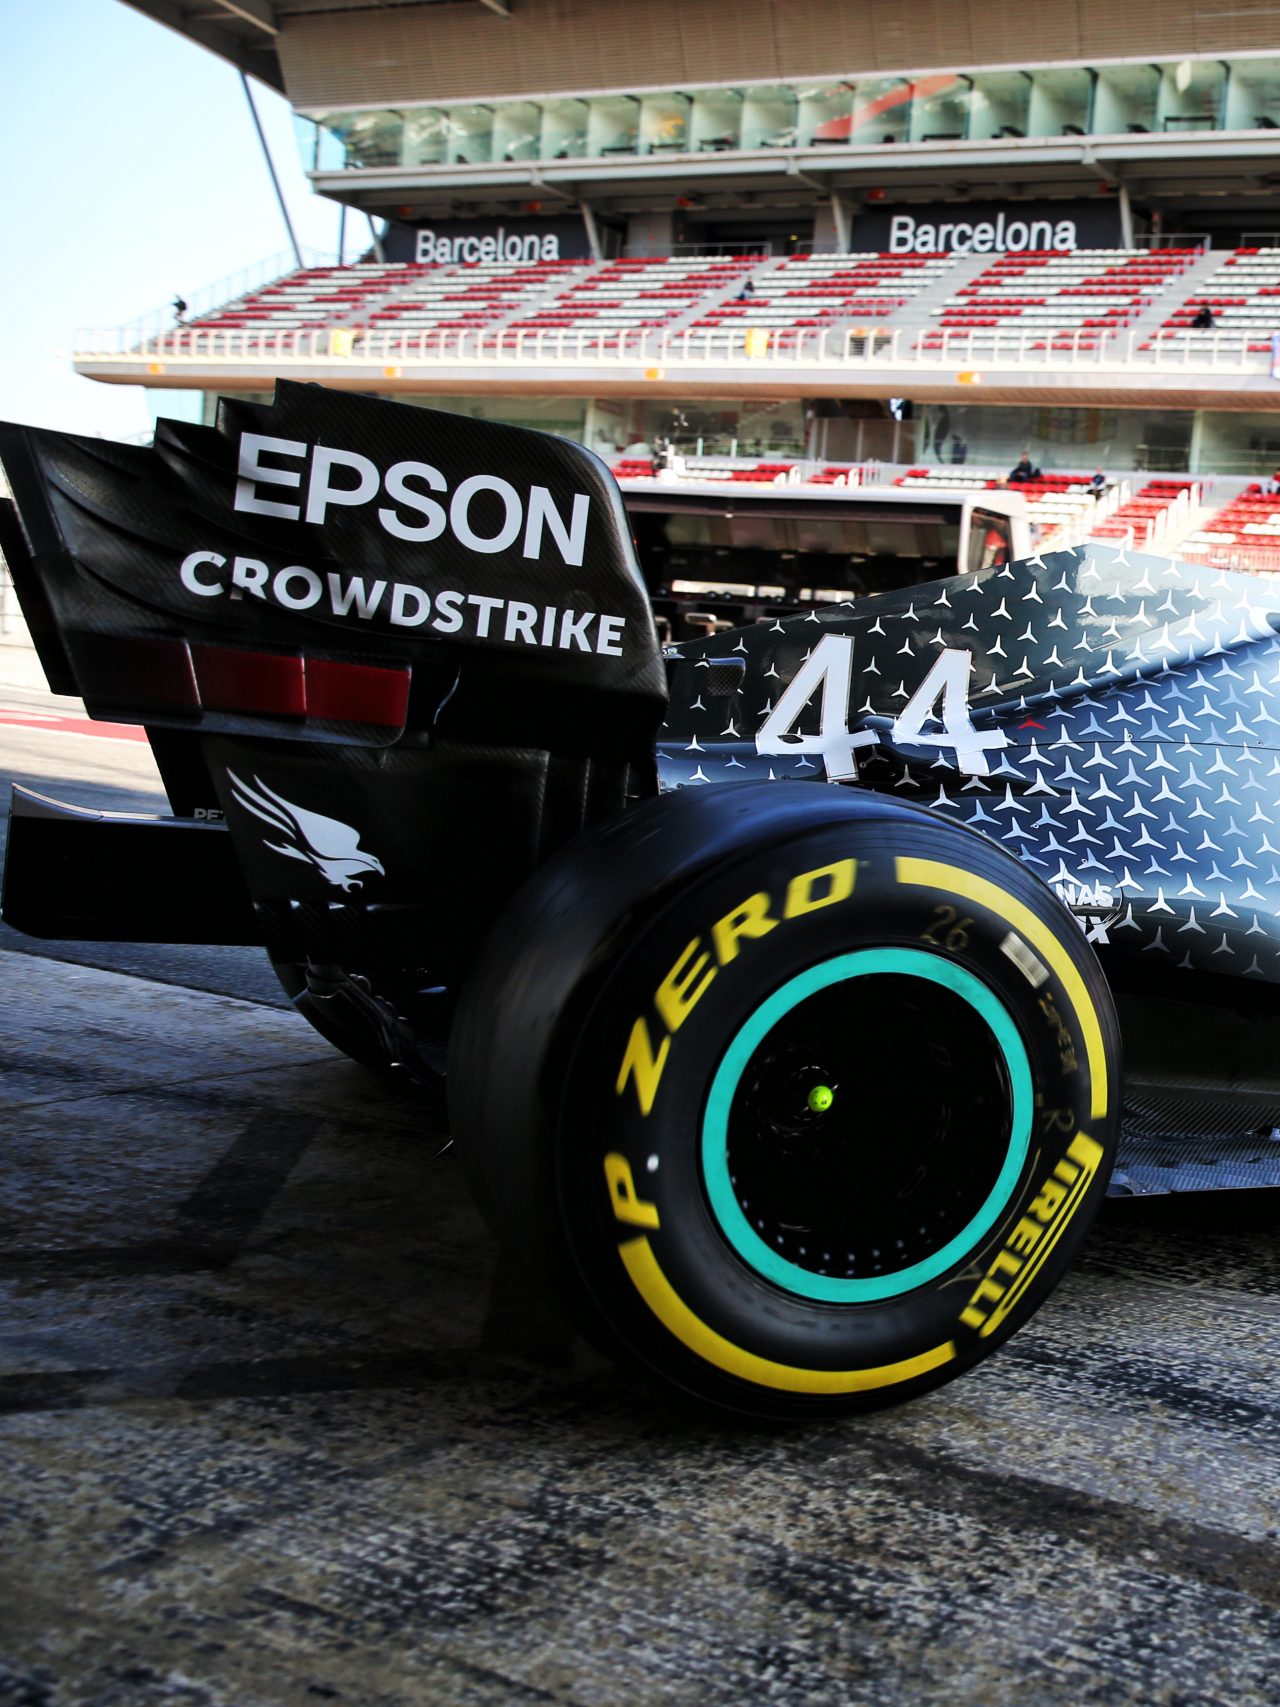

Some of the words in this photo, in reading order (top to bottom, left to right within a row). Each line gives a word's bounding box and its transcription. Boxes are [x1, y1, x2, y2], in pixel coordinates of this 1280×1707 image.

[414, 227, 560, 264] Barcelona
[889, 212, 1078, 254] Barcelona
[233, 432, 591, 567] EPSON
[179, 550, 627, 657] CROWDSTRIKE
[756, 633, 1008, 782] 44
[615, 857, 858, 1117] ZERO
[604, 1152, 660, 1230] P
[958, 1131, 1104, 1338] PIRELLI
